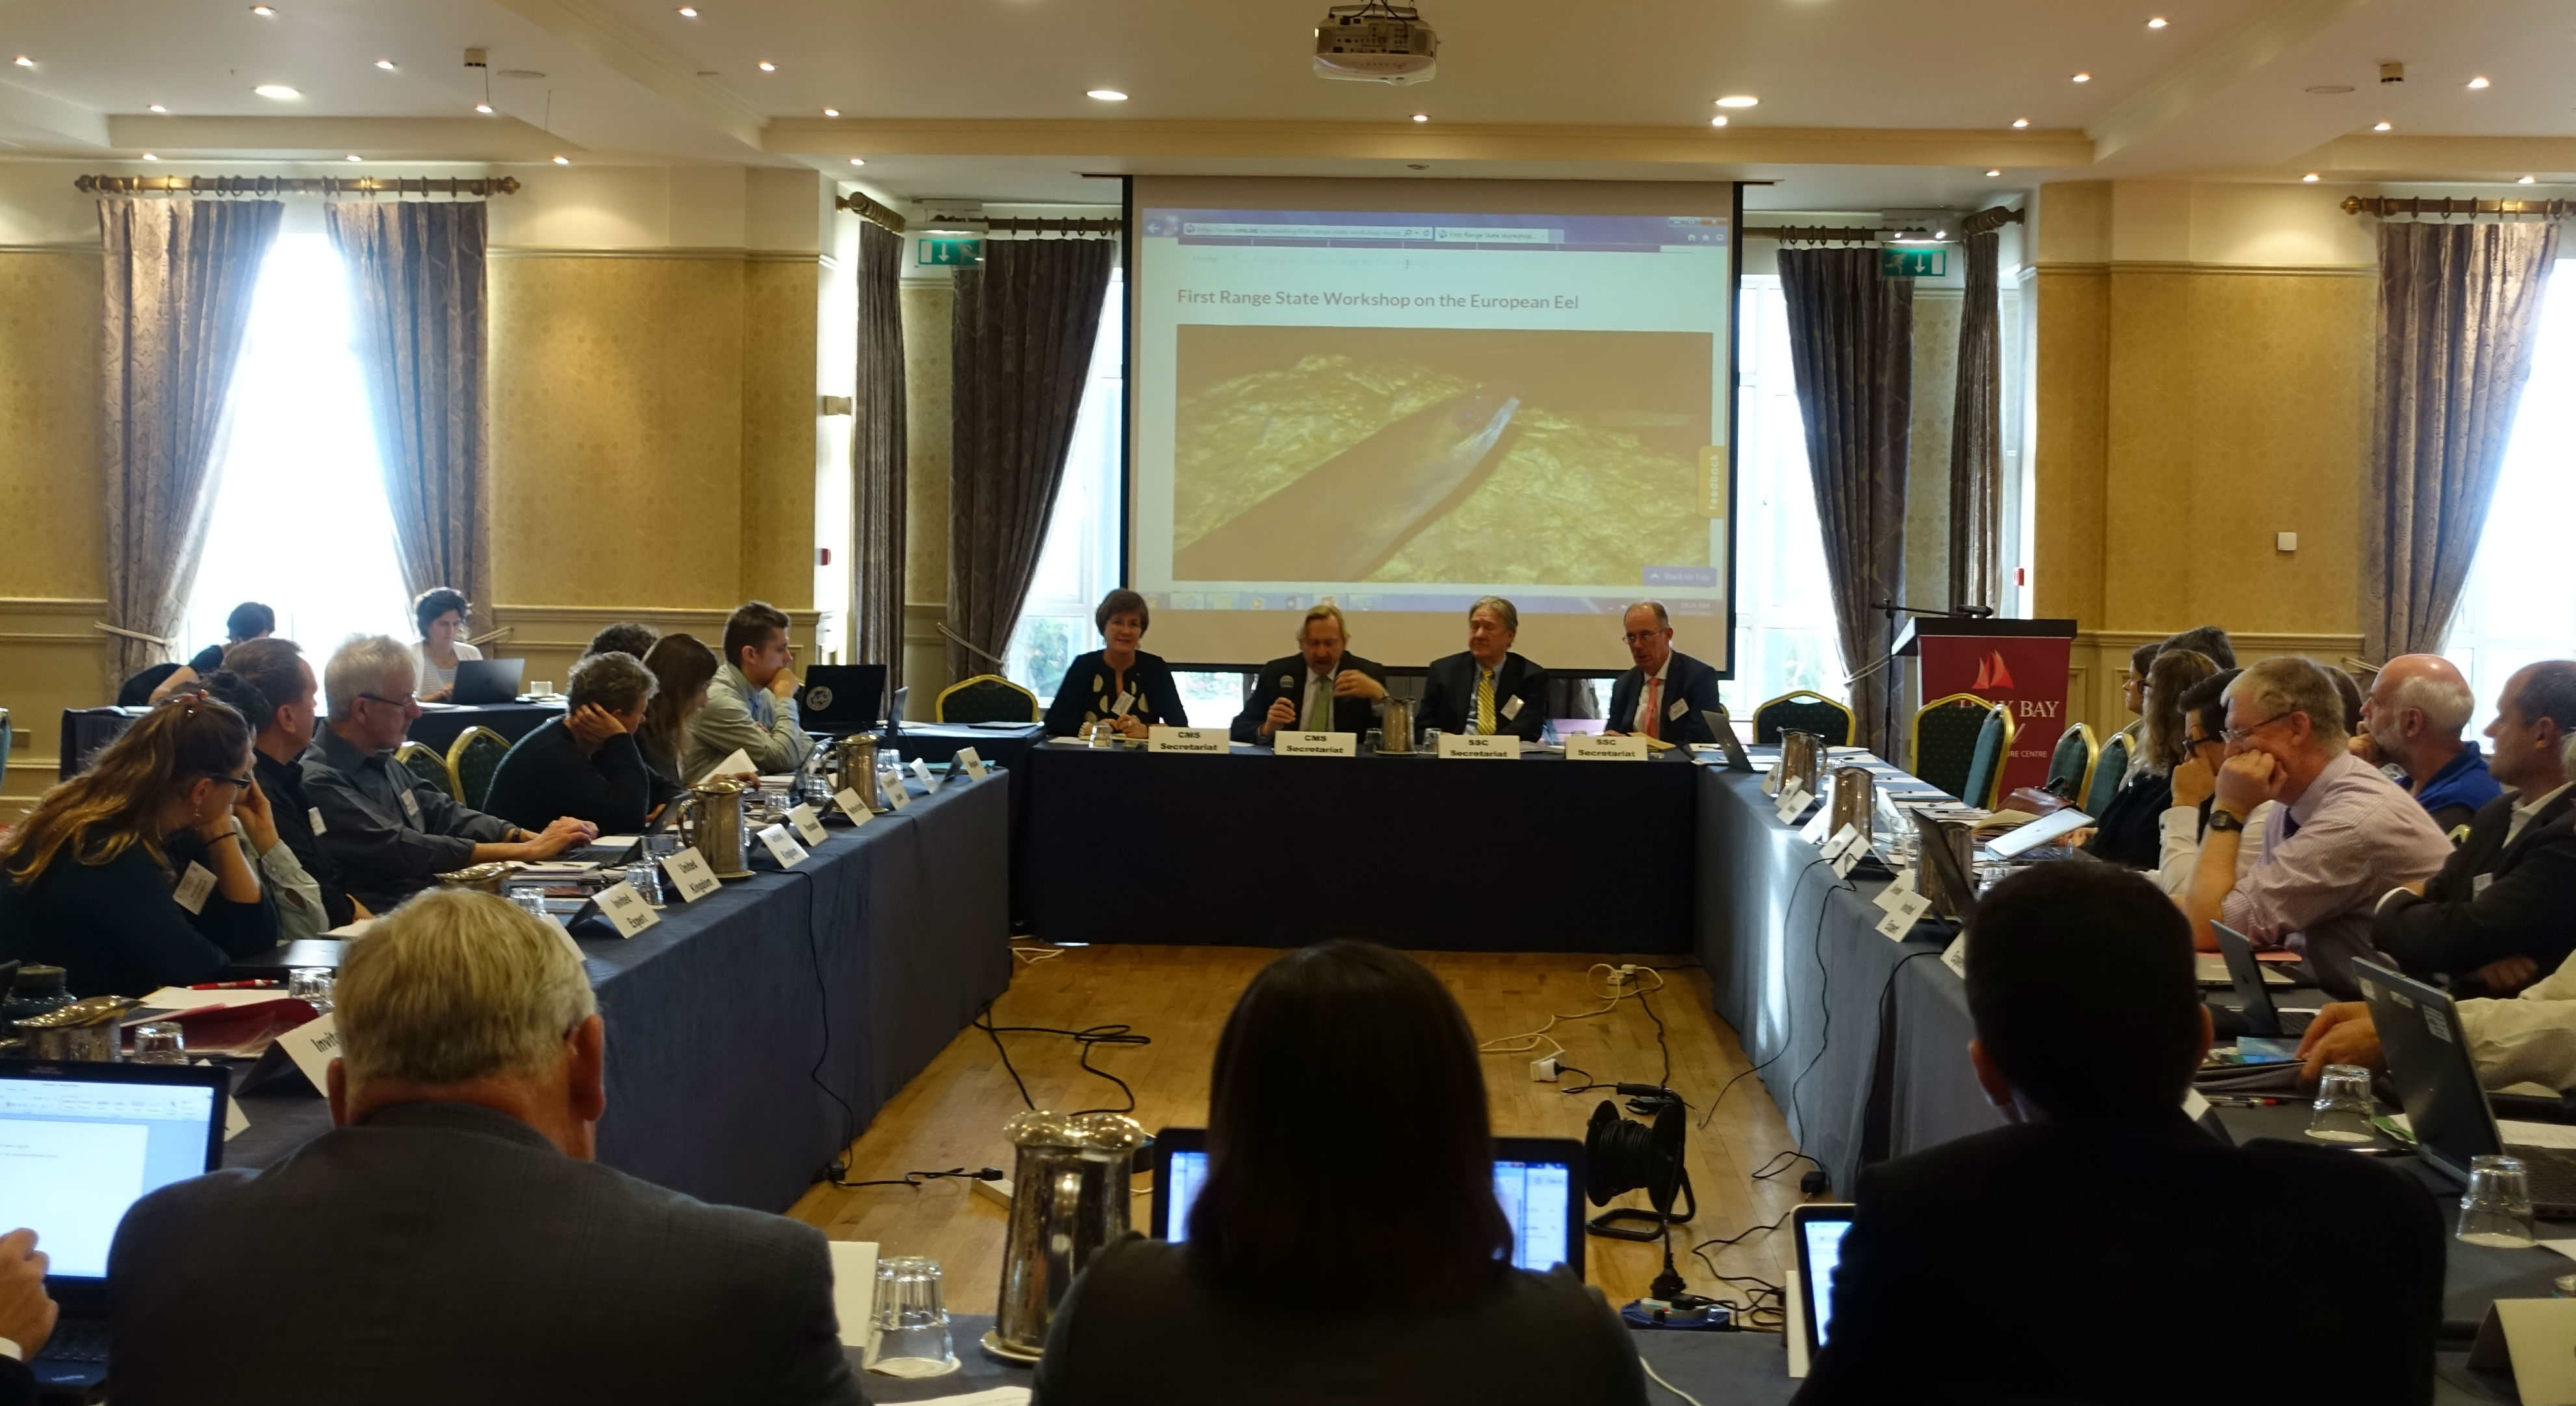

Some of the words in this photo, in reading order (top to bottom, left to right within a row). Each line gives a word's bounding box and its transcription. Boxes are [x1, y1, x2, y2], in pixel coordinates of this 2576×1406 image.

[1178, 290, 1215, 303] First
[1220, 290, 1271, 307] Range
[1275, 291, 1319, 305] State
[1323, 292, 1410, 309] Workshop
[1414, 296, 1435, 307] on
[1439, 294, 1466, 307] the
[1471, 294, 1549, 310] European
[1554, 295, 1579, 309] Eel
[2020, 700, 2060, 717] BAY
[1160, 743, 1218, 751] Secretariat
[1286, 745, 1344, 754] Secretariat
[1450, 749, 1508, 758] Secretariat
[1578, 749, 1636, 758] Secretariat
[678, 858, 699, 874] United
[688, 878, 714, 895] Kingdom
[610, 892, 634, 910] Invited
[626, 913, 649, 929] Expert
[310, 1031, 340, 1053] Invit
